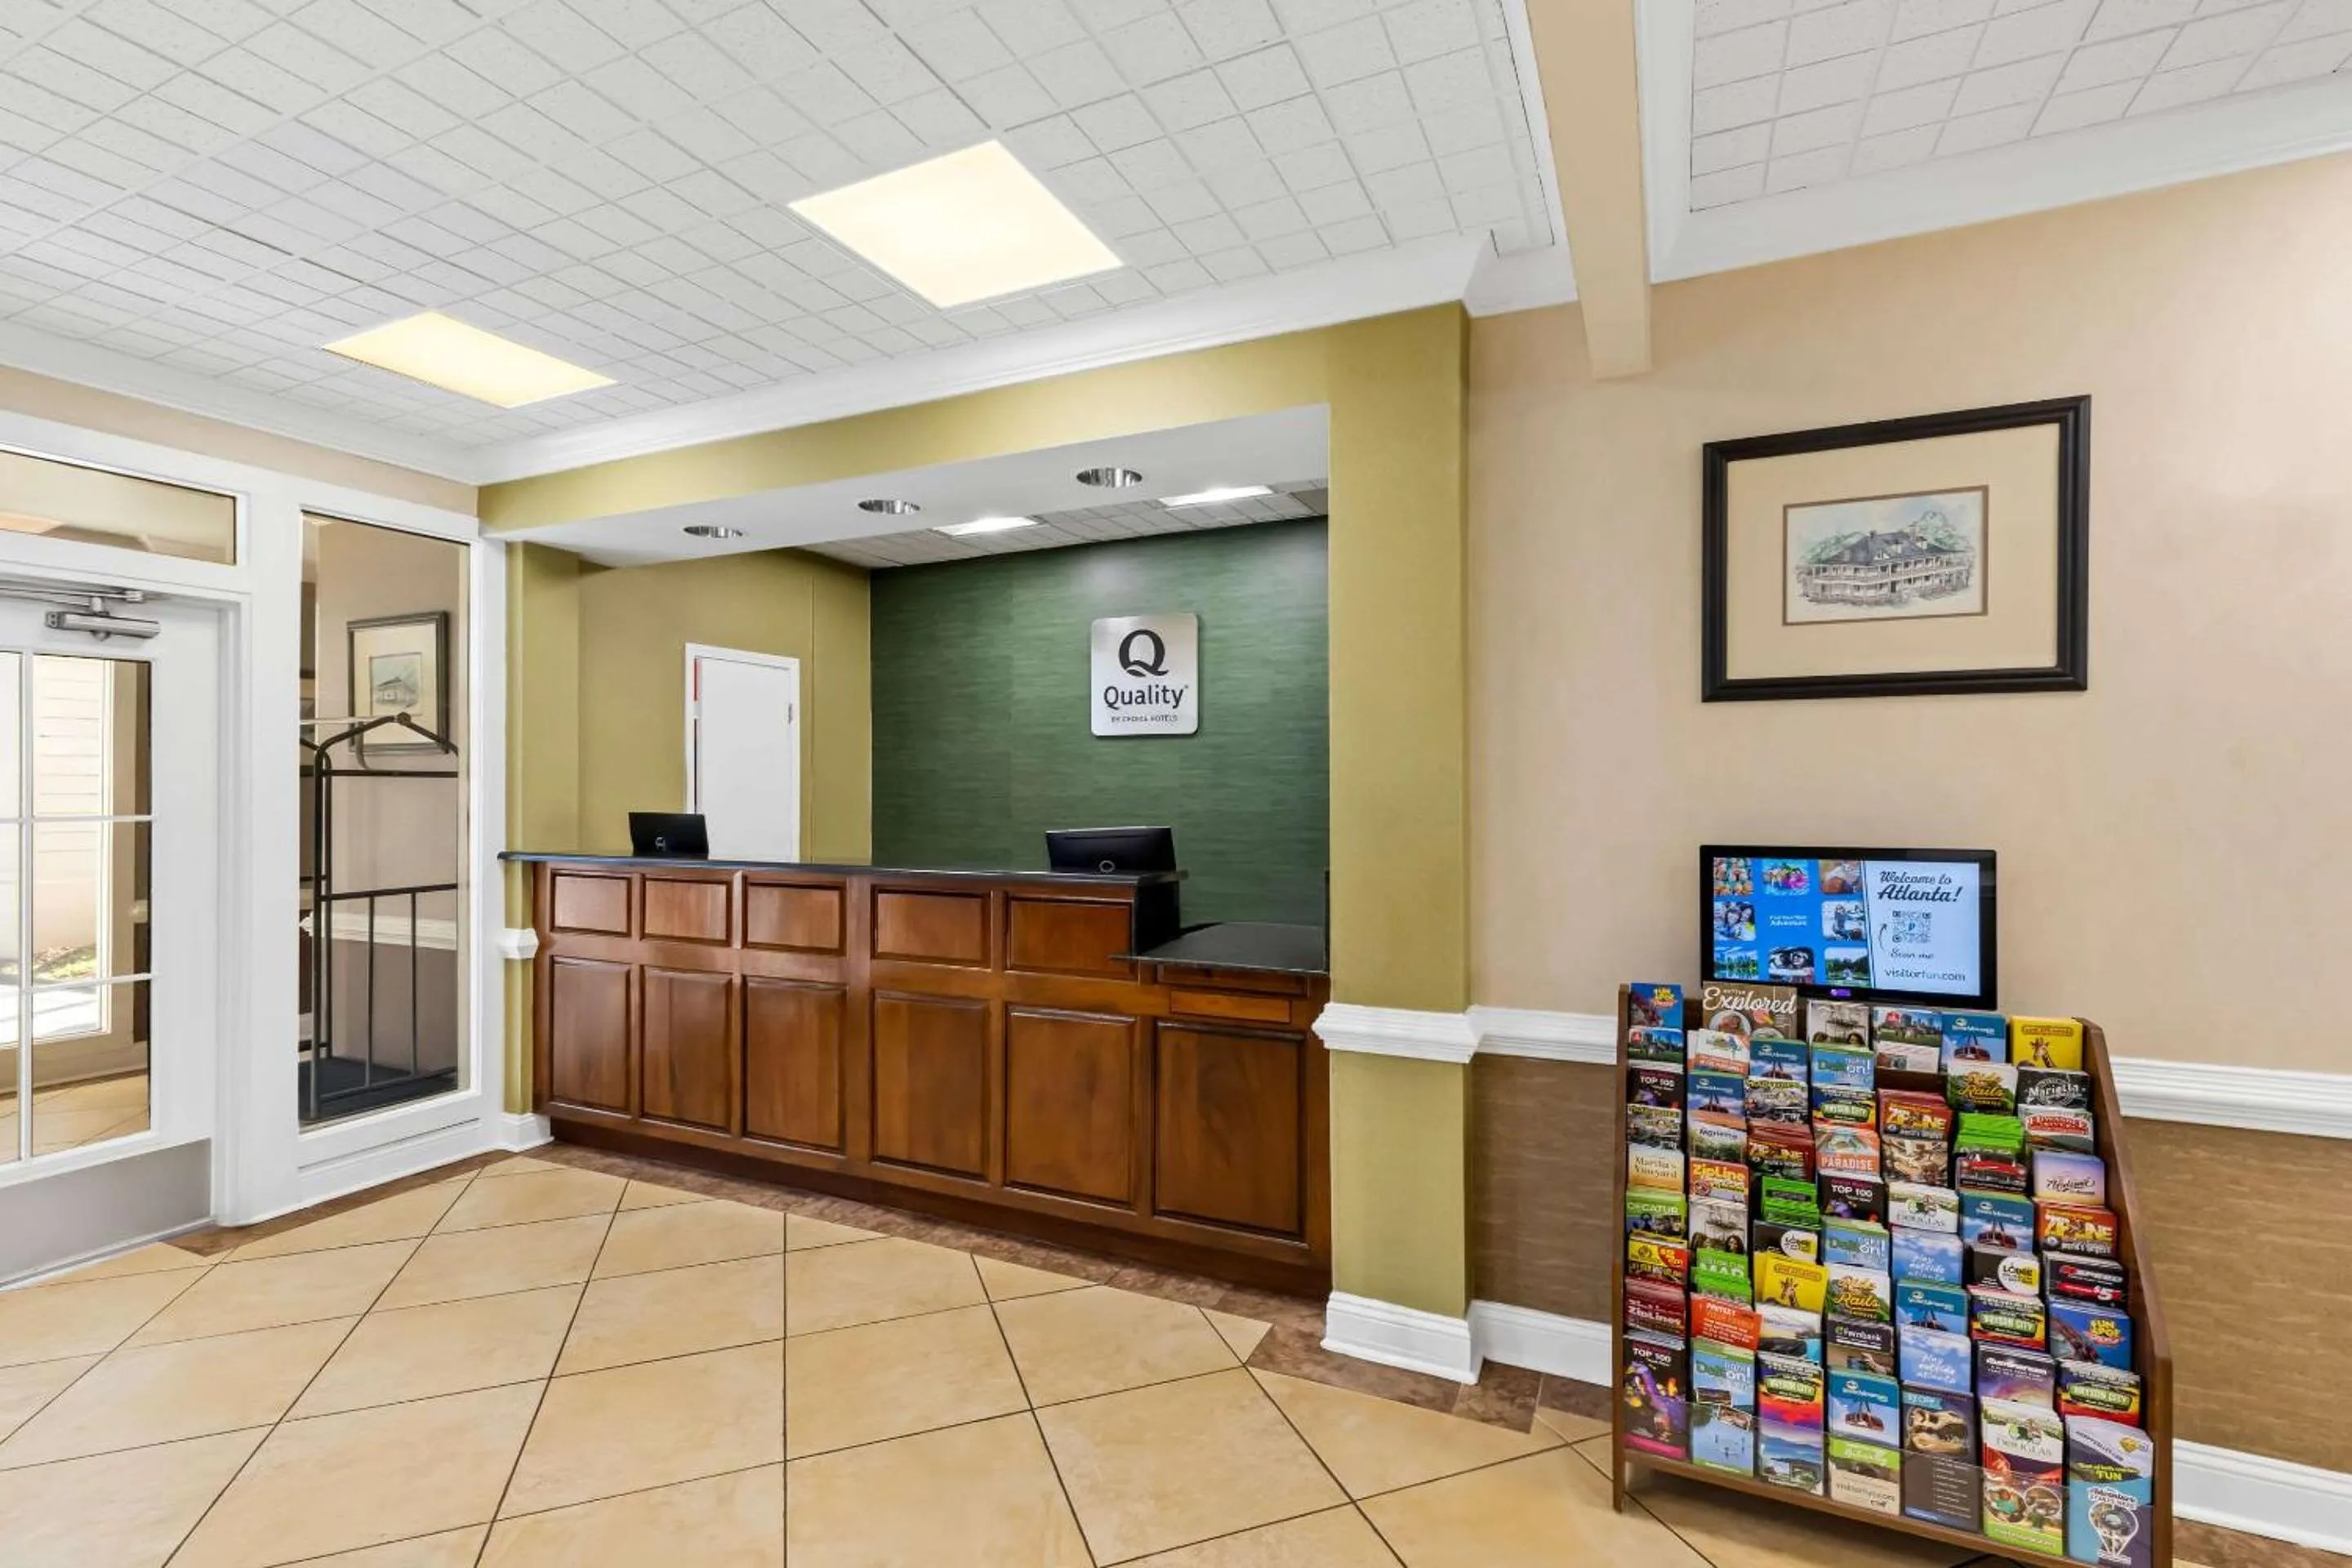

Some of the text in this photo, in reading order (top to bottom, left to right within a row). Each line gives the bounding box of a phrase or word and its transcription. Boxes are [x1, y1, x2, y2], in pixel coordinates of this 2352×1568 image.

[1118, 629, 1169, 678] Q
[1103, 684, 1184, 710] Quality
[1150, 714, 1178, 722] HOTELS
[1880, 870, 1953, 885] Welcome to
[1877, 884, 1963, 902] Atlanta!
[1885, 967, 1967, 982] visitorfun.com
[1702, 986, 1797, 1014] Explored
[1640, 1076, 1658, 1084] TOP
[2028, 1083, 2080, 1098] Marietta
[1821, 1156, 1874, 1170] PARADISE
[1693, 1163, 1746, 1180] ZipLine
[1832, 1184, 1873, 1198] TOP 100
[1834, 1292, 1881, 1308] Rails
[1844, 1328, 1882, 1342] Fernbank
[1633, 1348, 1653, 1357] TOP
